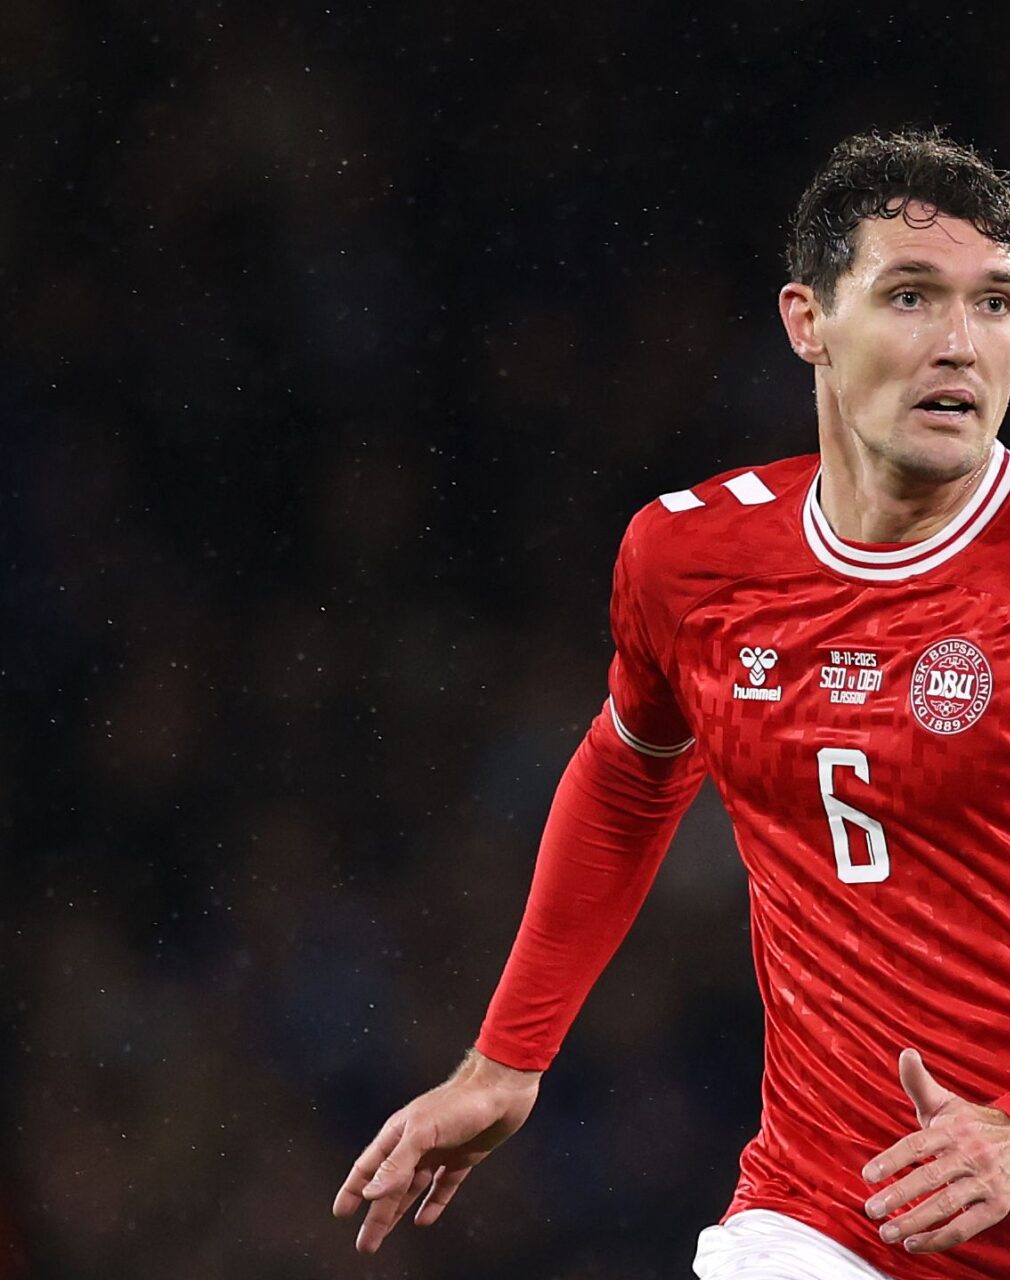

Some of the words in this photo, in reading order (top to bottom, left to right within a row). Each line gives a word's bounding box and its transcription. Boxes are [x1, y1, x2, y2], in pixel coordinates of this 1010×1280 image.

[830, 650, 877, 667] 18-11-2025
[819, 666, 847, 689] SCO
[856, 669, 883, 692] DEN
[913, 662, 930, 718] DANSK
[964, 672, 989, 722] UNION
[926, 669, 975, 700] DBU
[733, 683, 782, 702] hummel
[927, 717, 961, 731] 1889
[816, 747, 890, 884] 6
